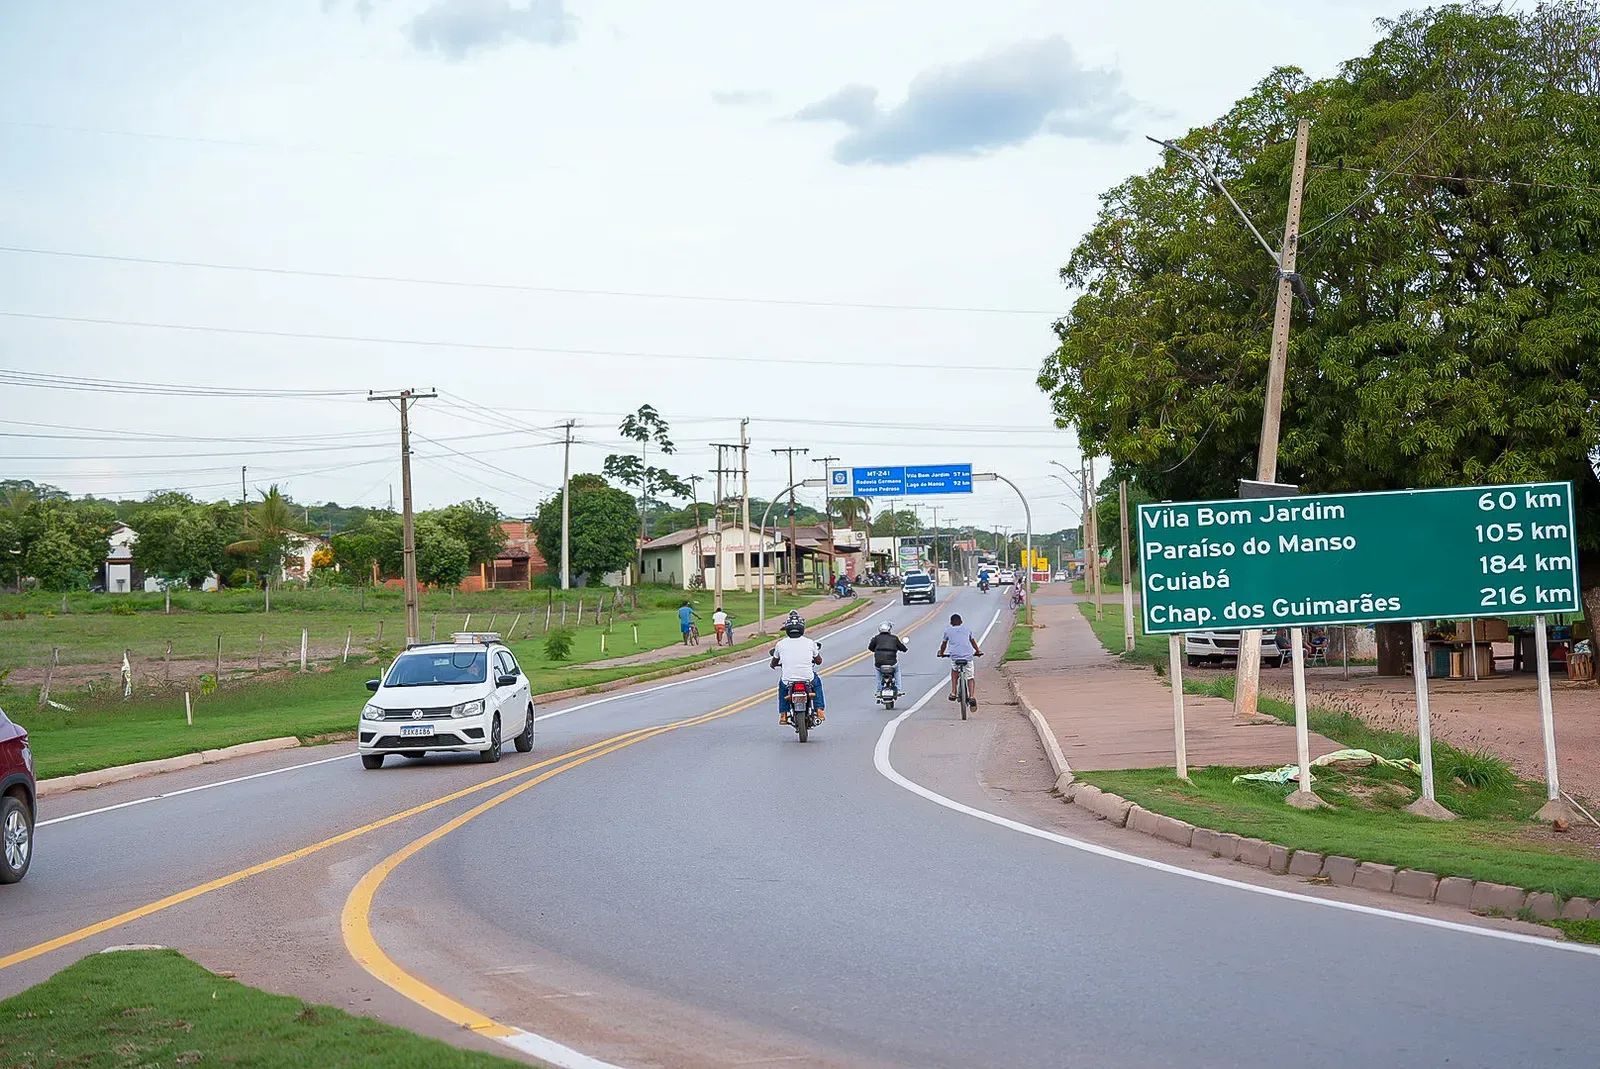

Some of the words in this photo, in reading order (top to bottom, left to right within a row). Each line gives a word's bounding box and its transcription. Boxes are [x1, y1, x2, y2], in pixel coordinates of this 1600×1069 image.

[1143, 507, 1189, 529] Vila
[1197, 507, 1252, 527] Bom
[1259, 502, 1346, 524] Jardim
[1478, 491, 1517, 511] 60
[1525, 490, 1562, 509] km
[1146, 538, 1236, 560] Paraíso
[1242, 536, 1271, 556] do
[1278, 534, 1357, 554] Manso
[1475, 522, 1524, 543] 105
[1531, 521, 1568, 540] km
[1148, 568, 1231, 592] Cuiabá
[1479, 553, 1528, 574] 184
[1535, 552, 1572, 571] km
[1150, 604, 1218, 626] Chap.
[1223, 601, 1266, 620] dos
[1272, 593, 1402, 617] Guimarães
[1479, 585, 1527, 607] 216
[1535, 585, 1572, 604] km
